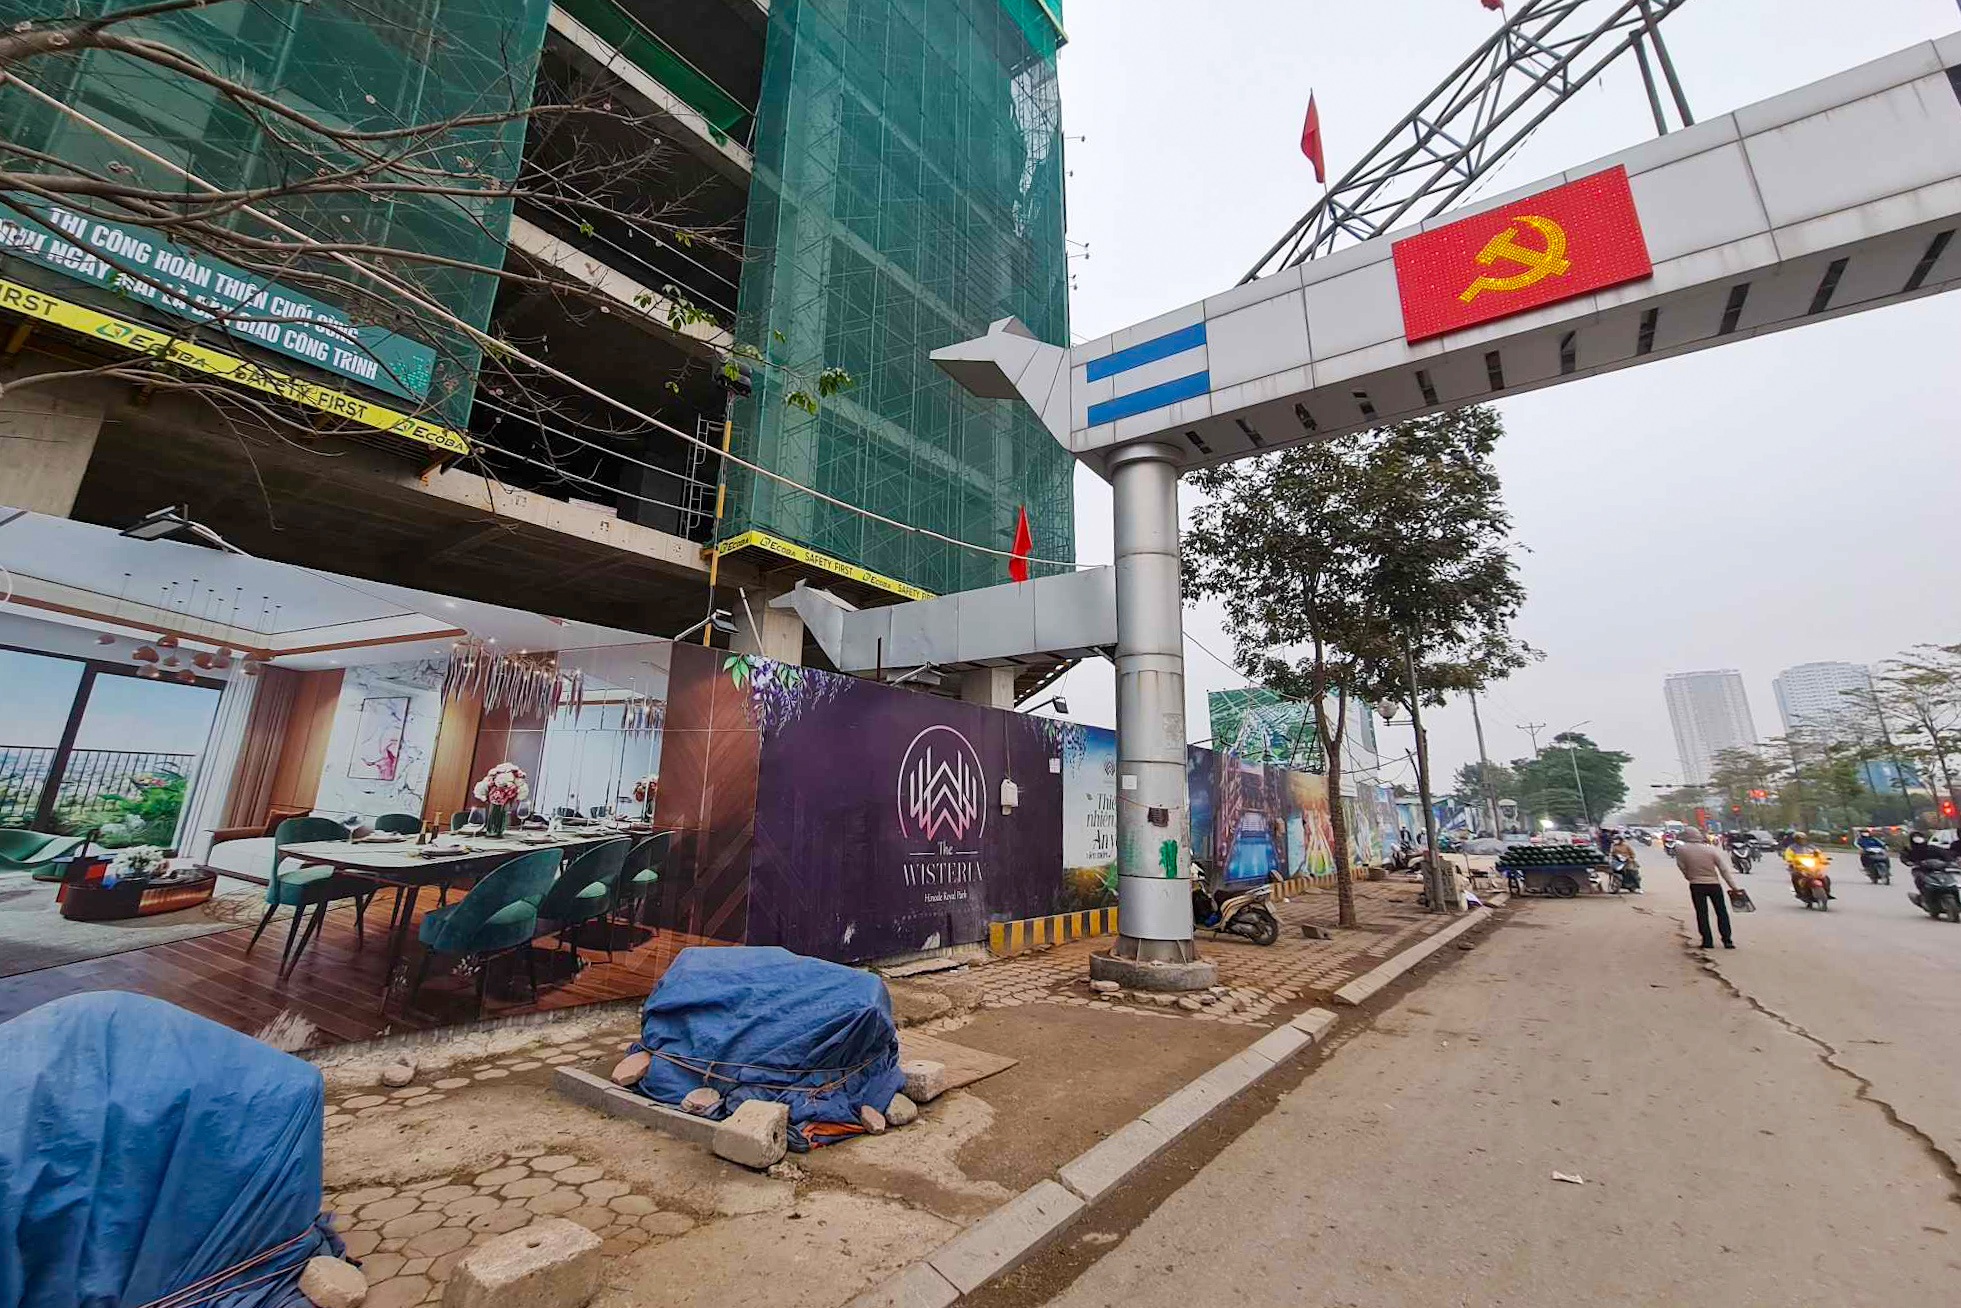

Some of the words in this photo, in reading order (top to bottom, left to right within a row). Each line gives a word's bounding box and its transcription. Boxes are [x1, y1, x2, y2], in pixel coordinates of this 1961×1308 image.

[51, 207, 88, 239] THI
[90, 225, 152, 264] CÔNG
[154, 249, 212, 288] HOÀN
[214, 272, 269, 311] THIỆN
[270, 296, 313, 328] CUỐI
[235, 312, 282, 344] GIAO
[283, 329, 331, 361] CÔNG
[332, 346, 379, 381] TRÌNH
[317, 391, 368, 420] FIRST
[804, 550, 832, 569] SAFETY
[834, 563, 853, 577] FIRST
[897, 583, 919, 599] SAFETY
[937, 839, 954, 857] The
[903, 860, 983, 887] WISTERIA
